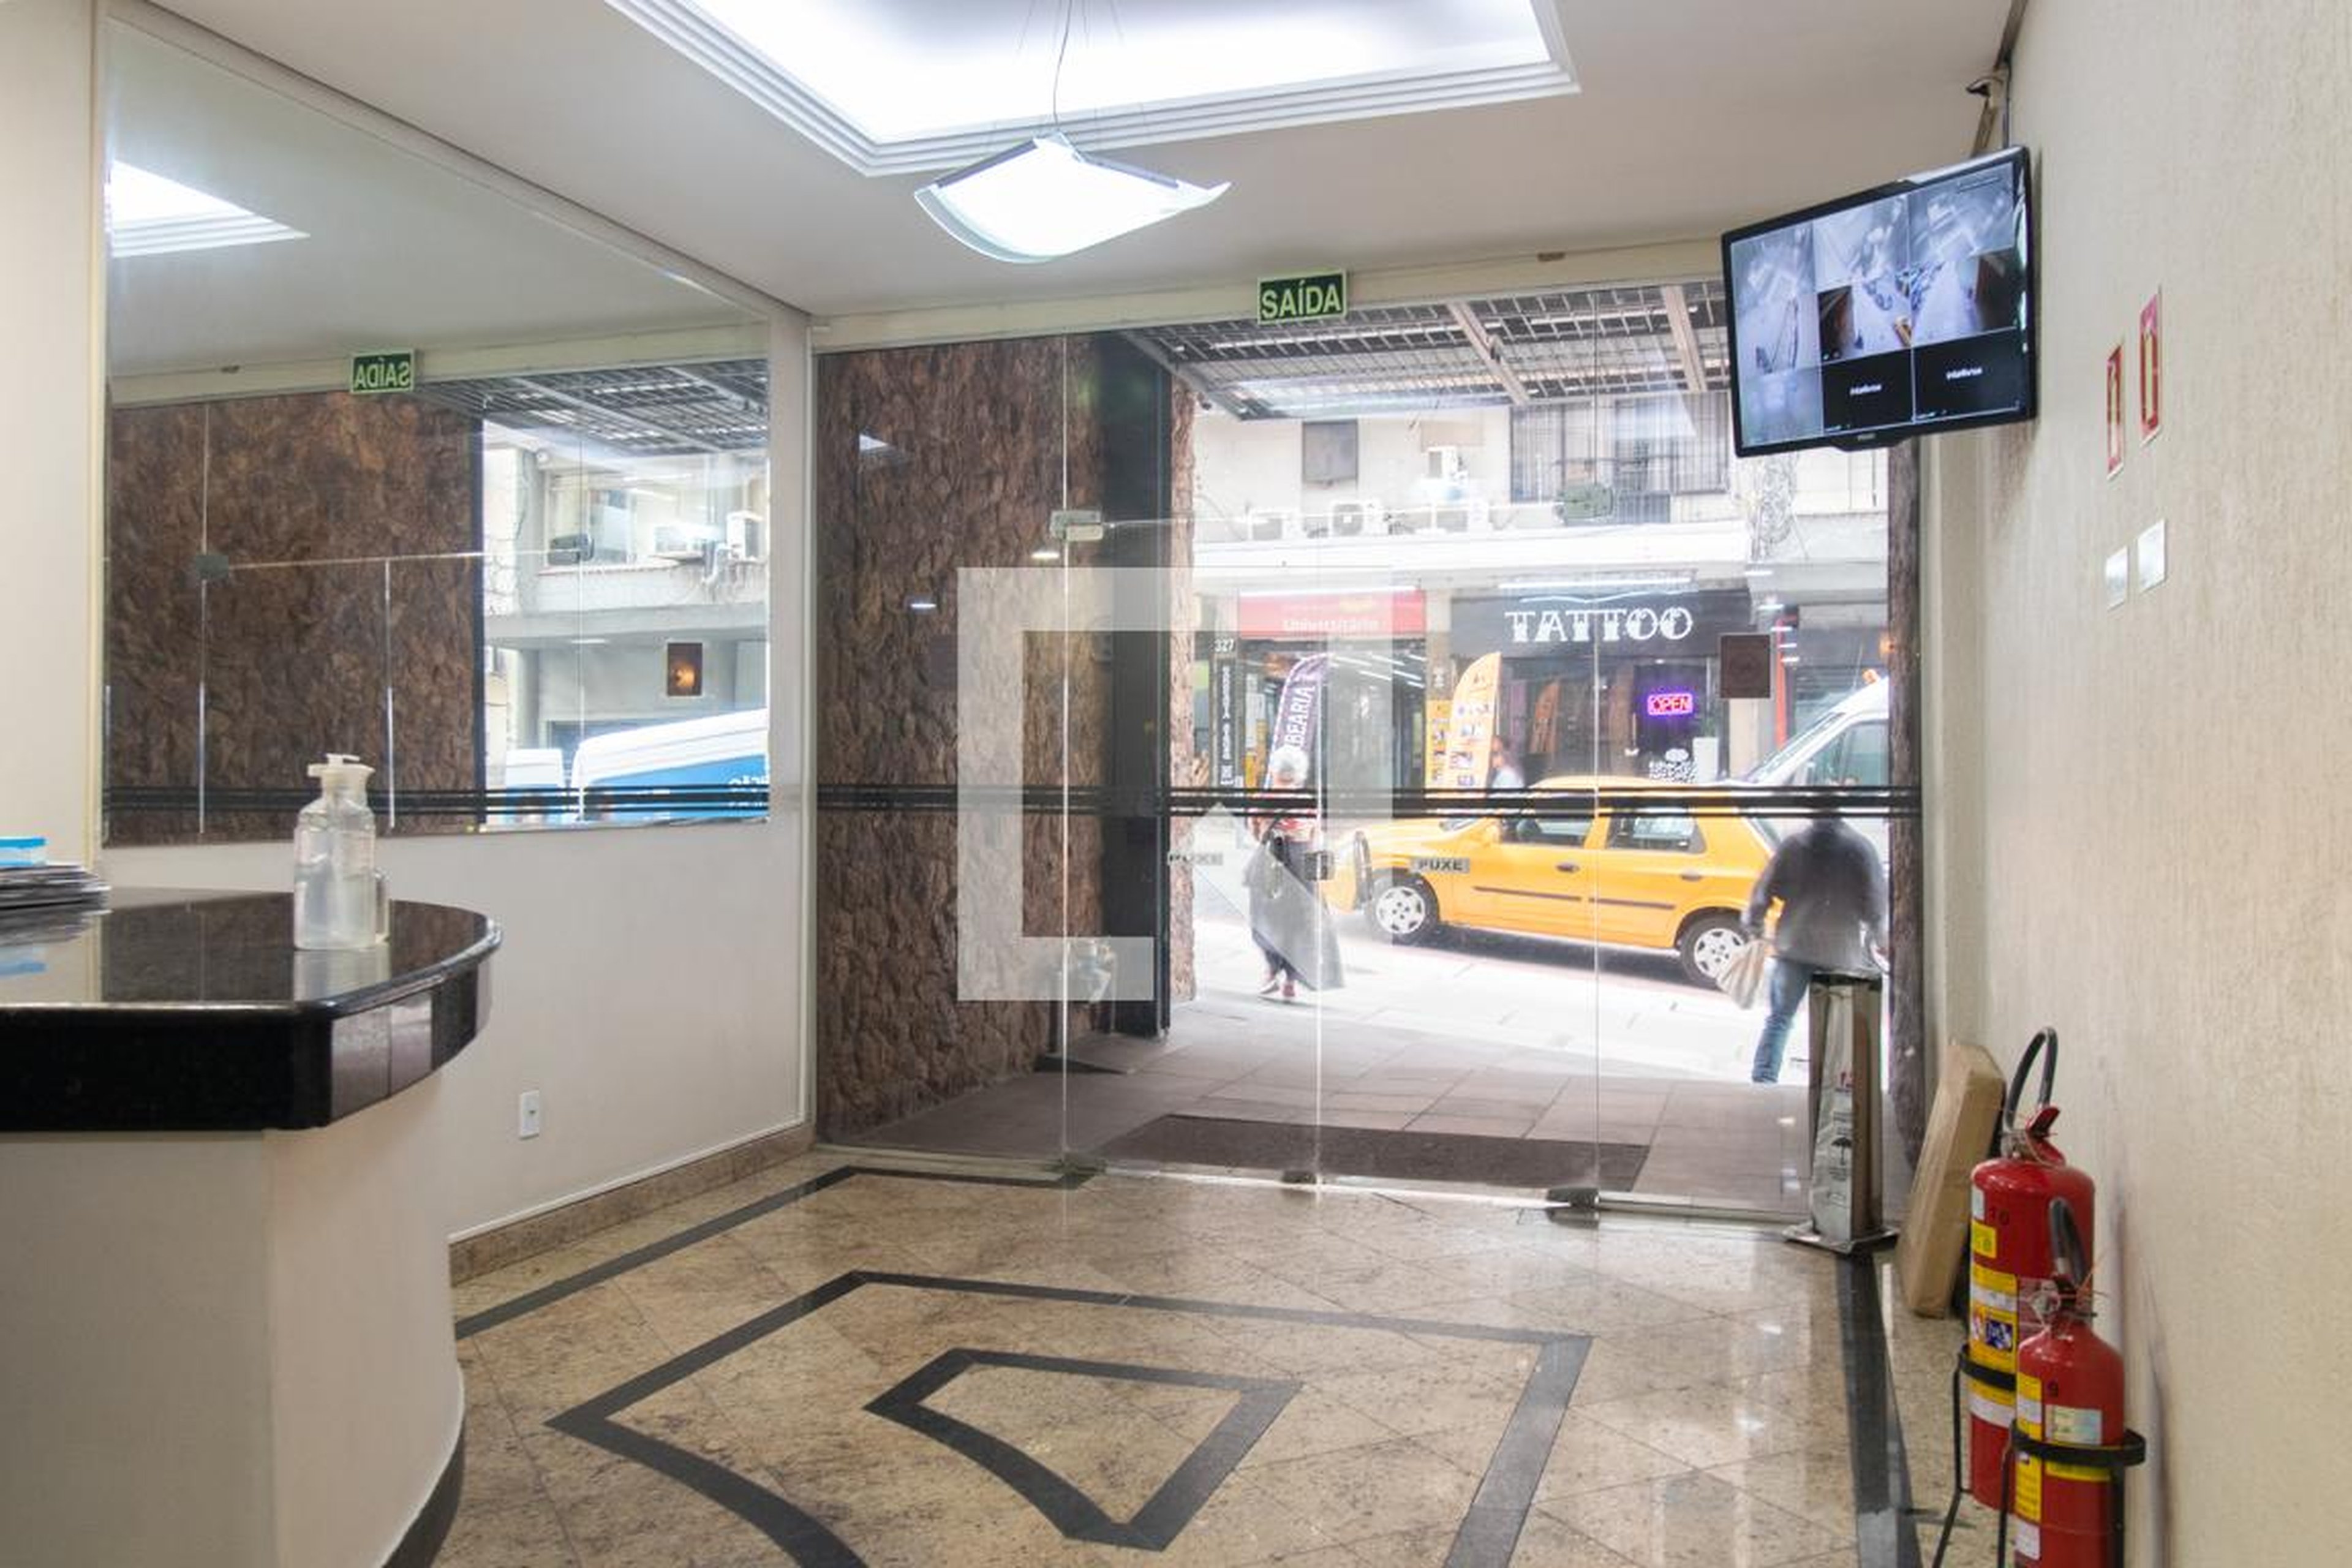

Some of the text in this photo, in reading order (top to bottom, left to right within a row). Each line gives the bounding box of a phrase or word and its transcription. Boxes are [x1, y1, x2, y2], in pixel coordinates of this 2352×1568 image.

[1261, 279, 1341, 319] SAÍDA
[1504, 606, 1694, 643] TATTOO
[1213, 638, 1234, 653] 327
[1284, 685, 1316, 747] BEARIA
[1649, 695, 1690, 714] OPEN
[1417, 858, 1463, 871] PUXE
